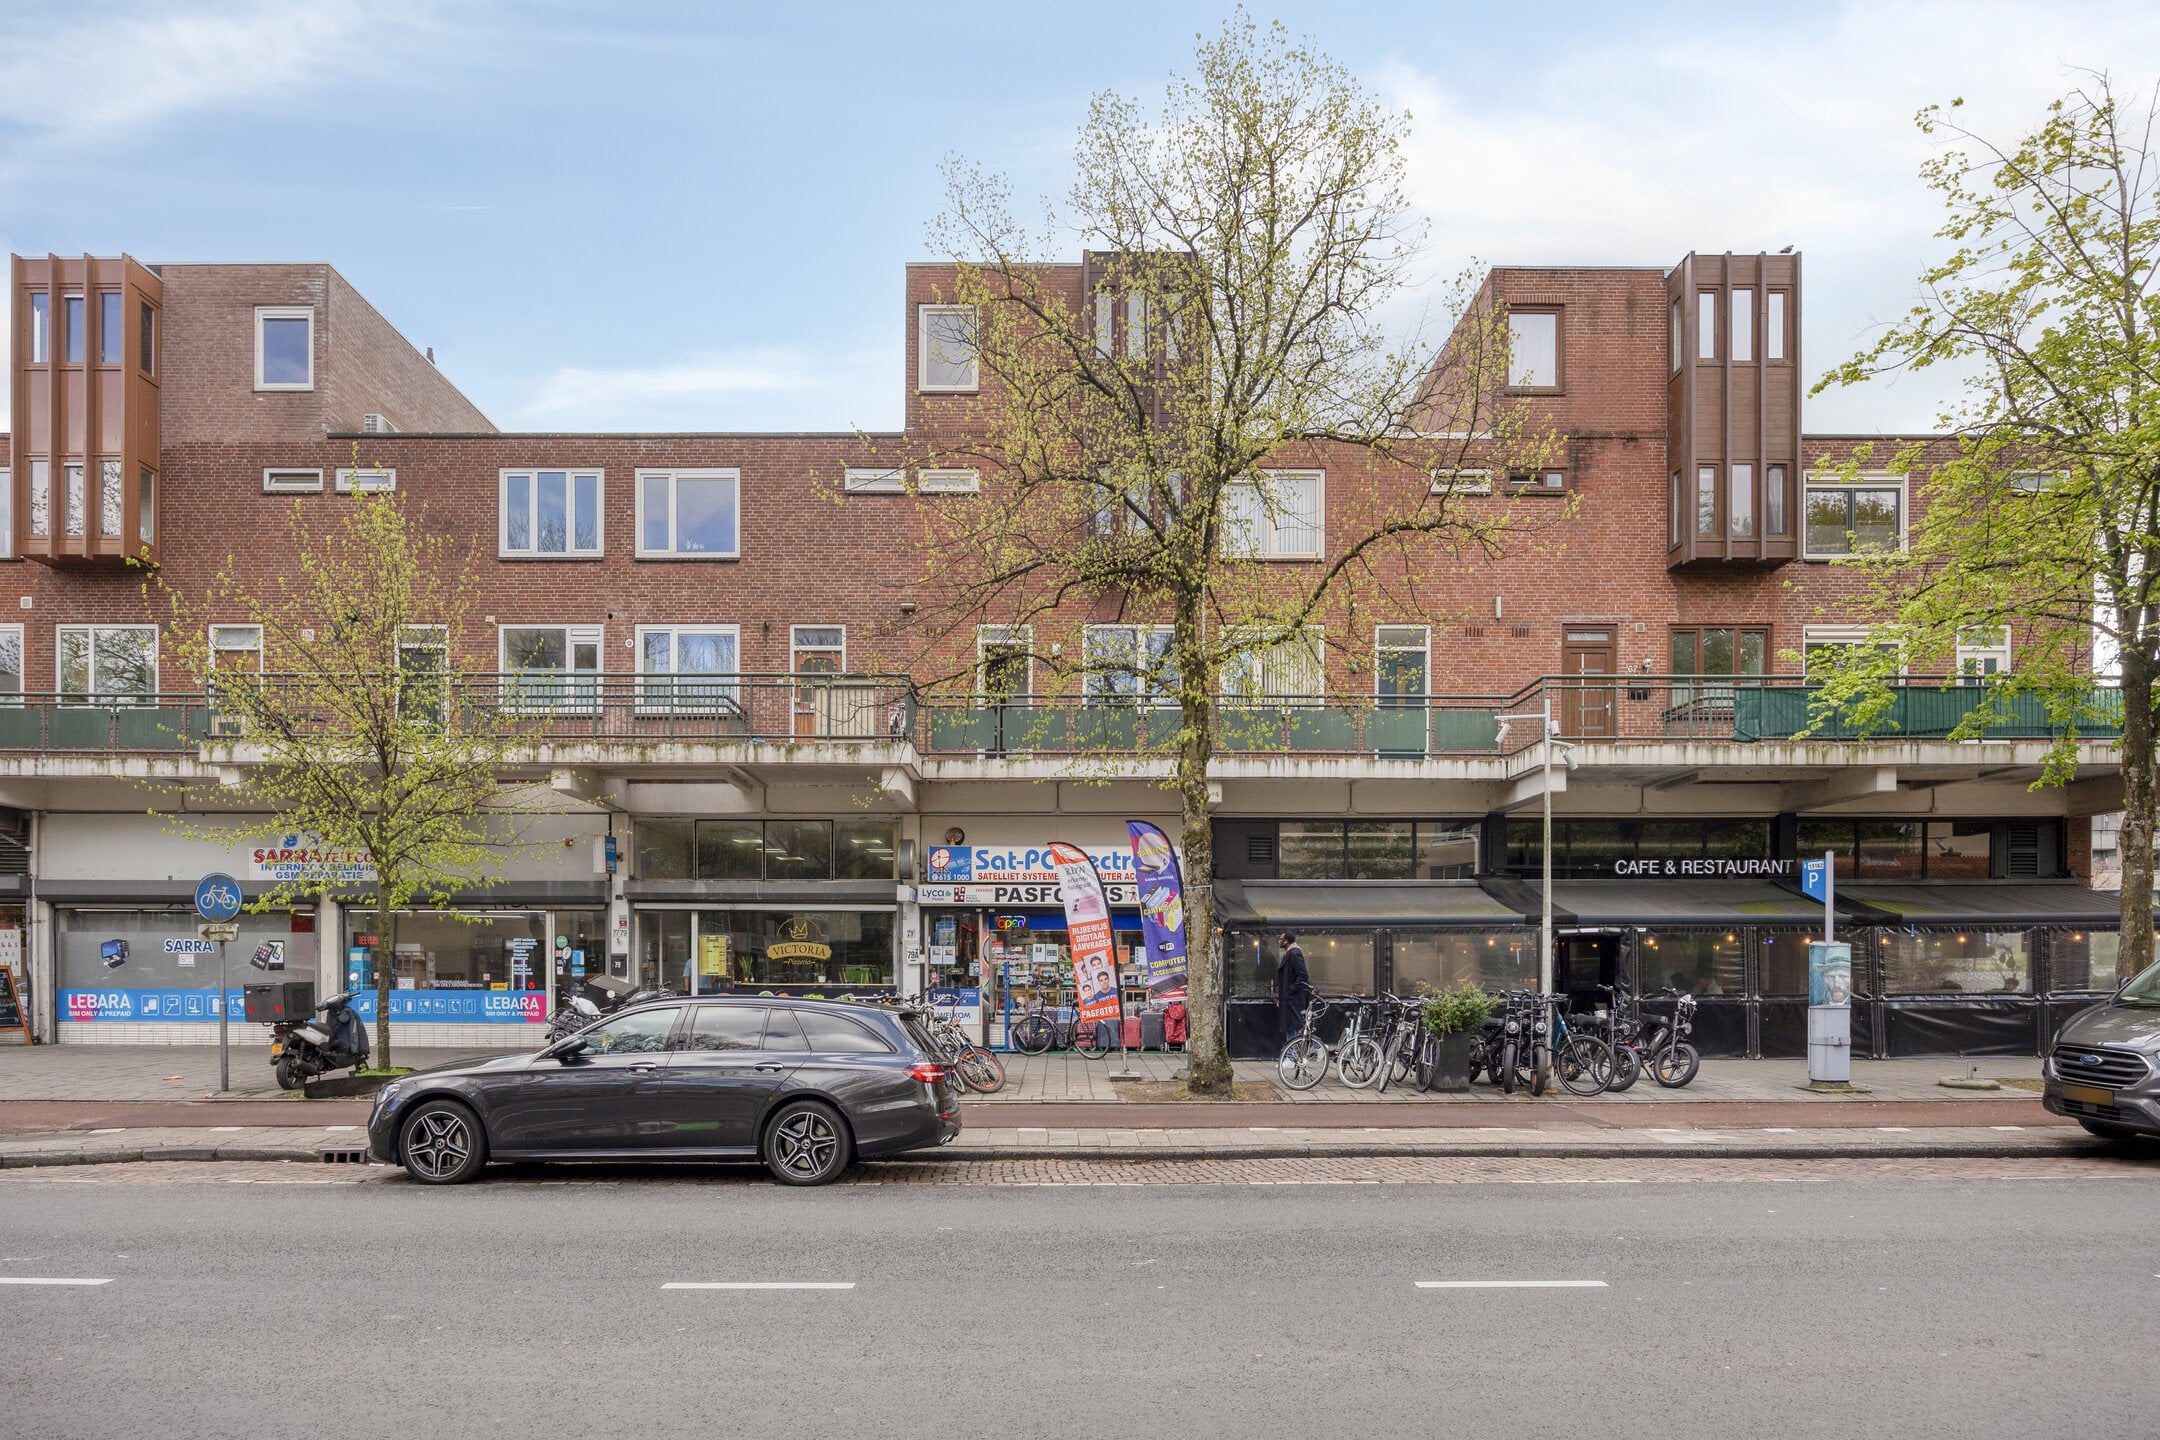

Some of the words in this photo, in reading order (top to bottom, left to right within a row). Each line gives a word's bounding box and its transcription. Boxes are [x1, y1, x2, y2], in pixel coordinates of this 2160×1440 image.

[253, 849, 322, 863] SARRA
[975, 849, 1054, 870] Sat-PC
[1615, 860, 1660, 874] CAFE
[1664, 860, 1677, 874] &
[1681, 859, 1795, 874] RESTAURANT
[275, 871, 299, 879] GSM
[977, 872, 1020, 880] SATELLIET
[1022, 872, 1059, 880] SYSTEME
[1808, 871, 1819, 889] P
[922, 888, 944, 898] Lyca
[1072, 922, 1108, 936] RIJBEWIJS
[1075, 930, 1107, 944] DIGITAAL
[165, 940, 213, 952] SARRA
[772, 944, 827, 957] VICTORIA
[1150, 955, 1186, 969] COMPUTER
[68, 993, 131, 1008] LEBARA
[485, 996, 539, 1009] LEBARA
[1081, 1005, 1120, 1019] PASFOTO'S
